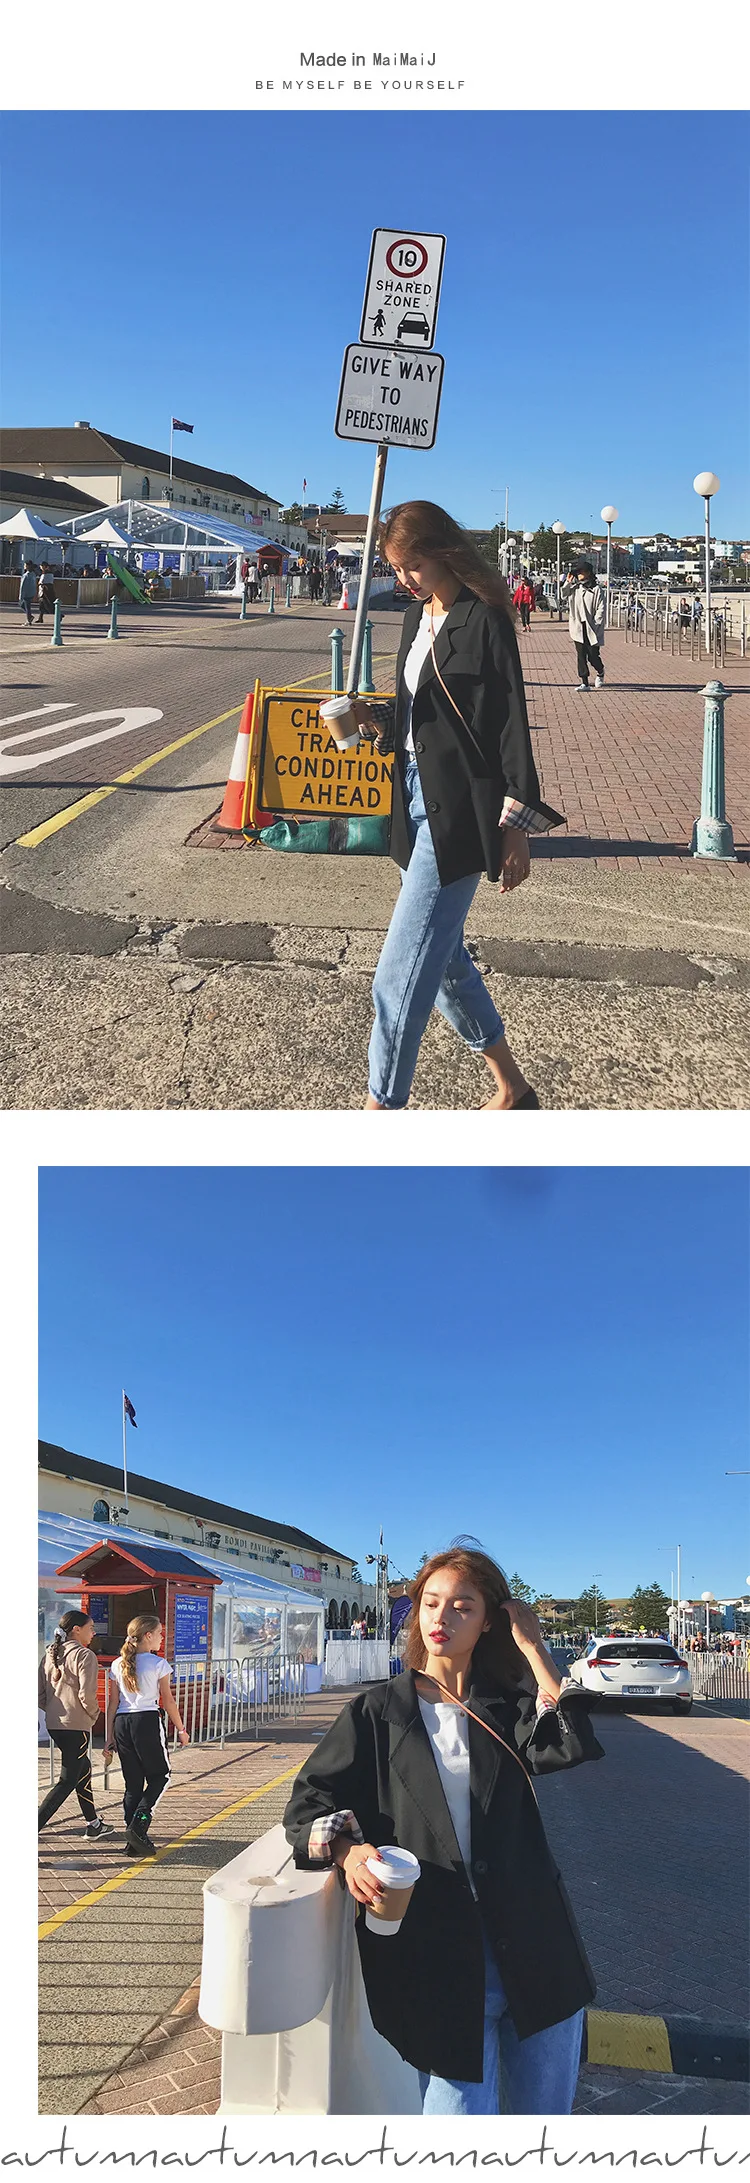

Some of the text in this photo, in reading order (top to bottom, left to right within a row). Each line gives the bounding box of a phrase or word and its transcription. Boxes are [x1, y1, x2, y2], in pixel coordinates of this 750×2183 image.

[398, 249, 418, 268] 10
[376, 279, 432, 295] SHARED
[383, 295, 421, 309] ZONE
[351, 355, 438, 383] GIVE WAY
[380, 386, 401, 406] TO
[344, 409, 429, 437] PEDESTRIANS
[300, 782, 381, 809] AHEAD
[250, 1542, 277, 1556] PAVILIO
